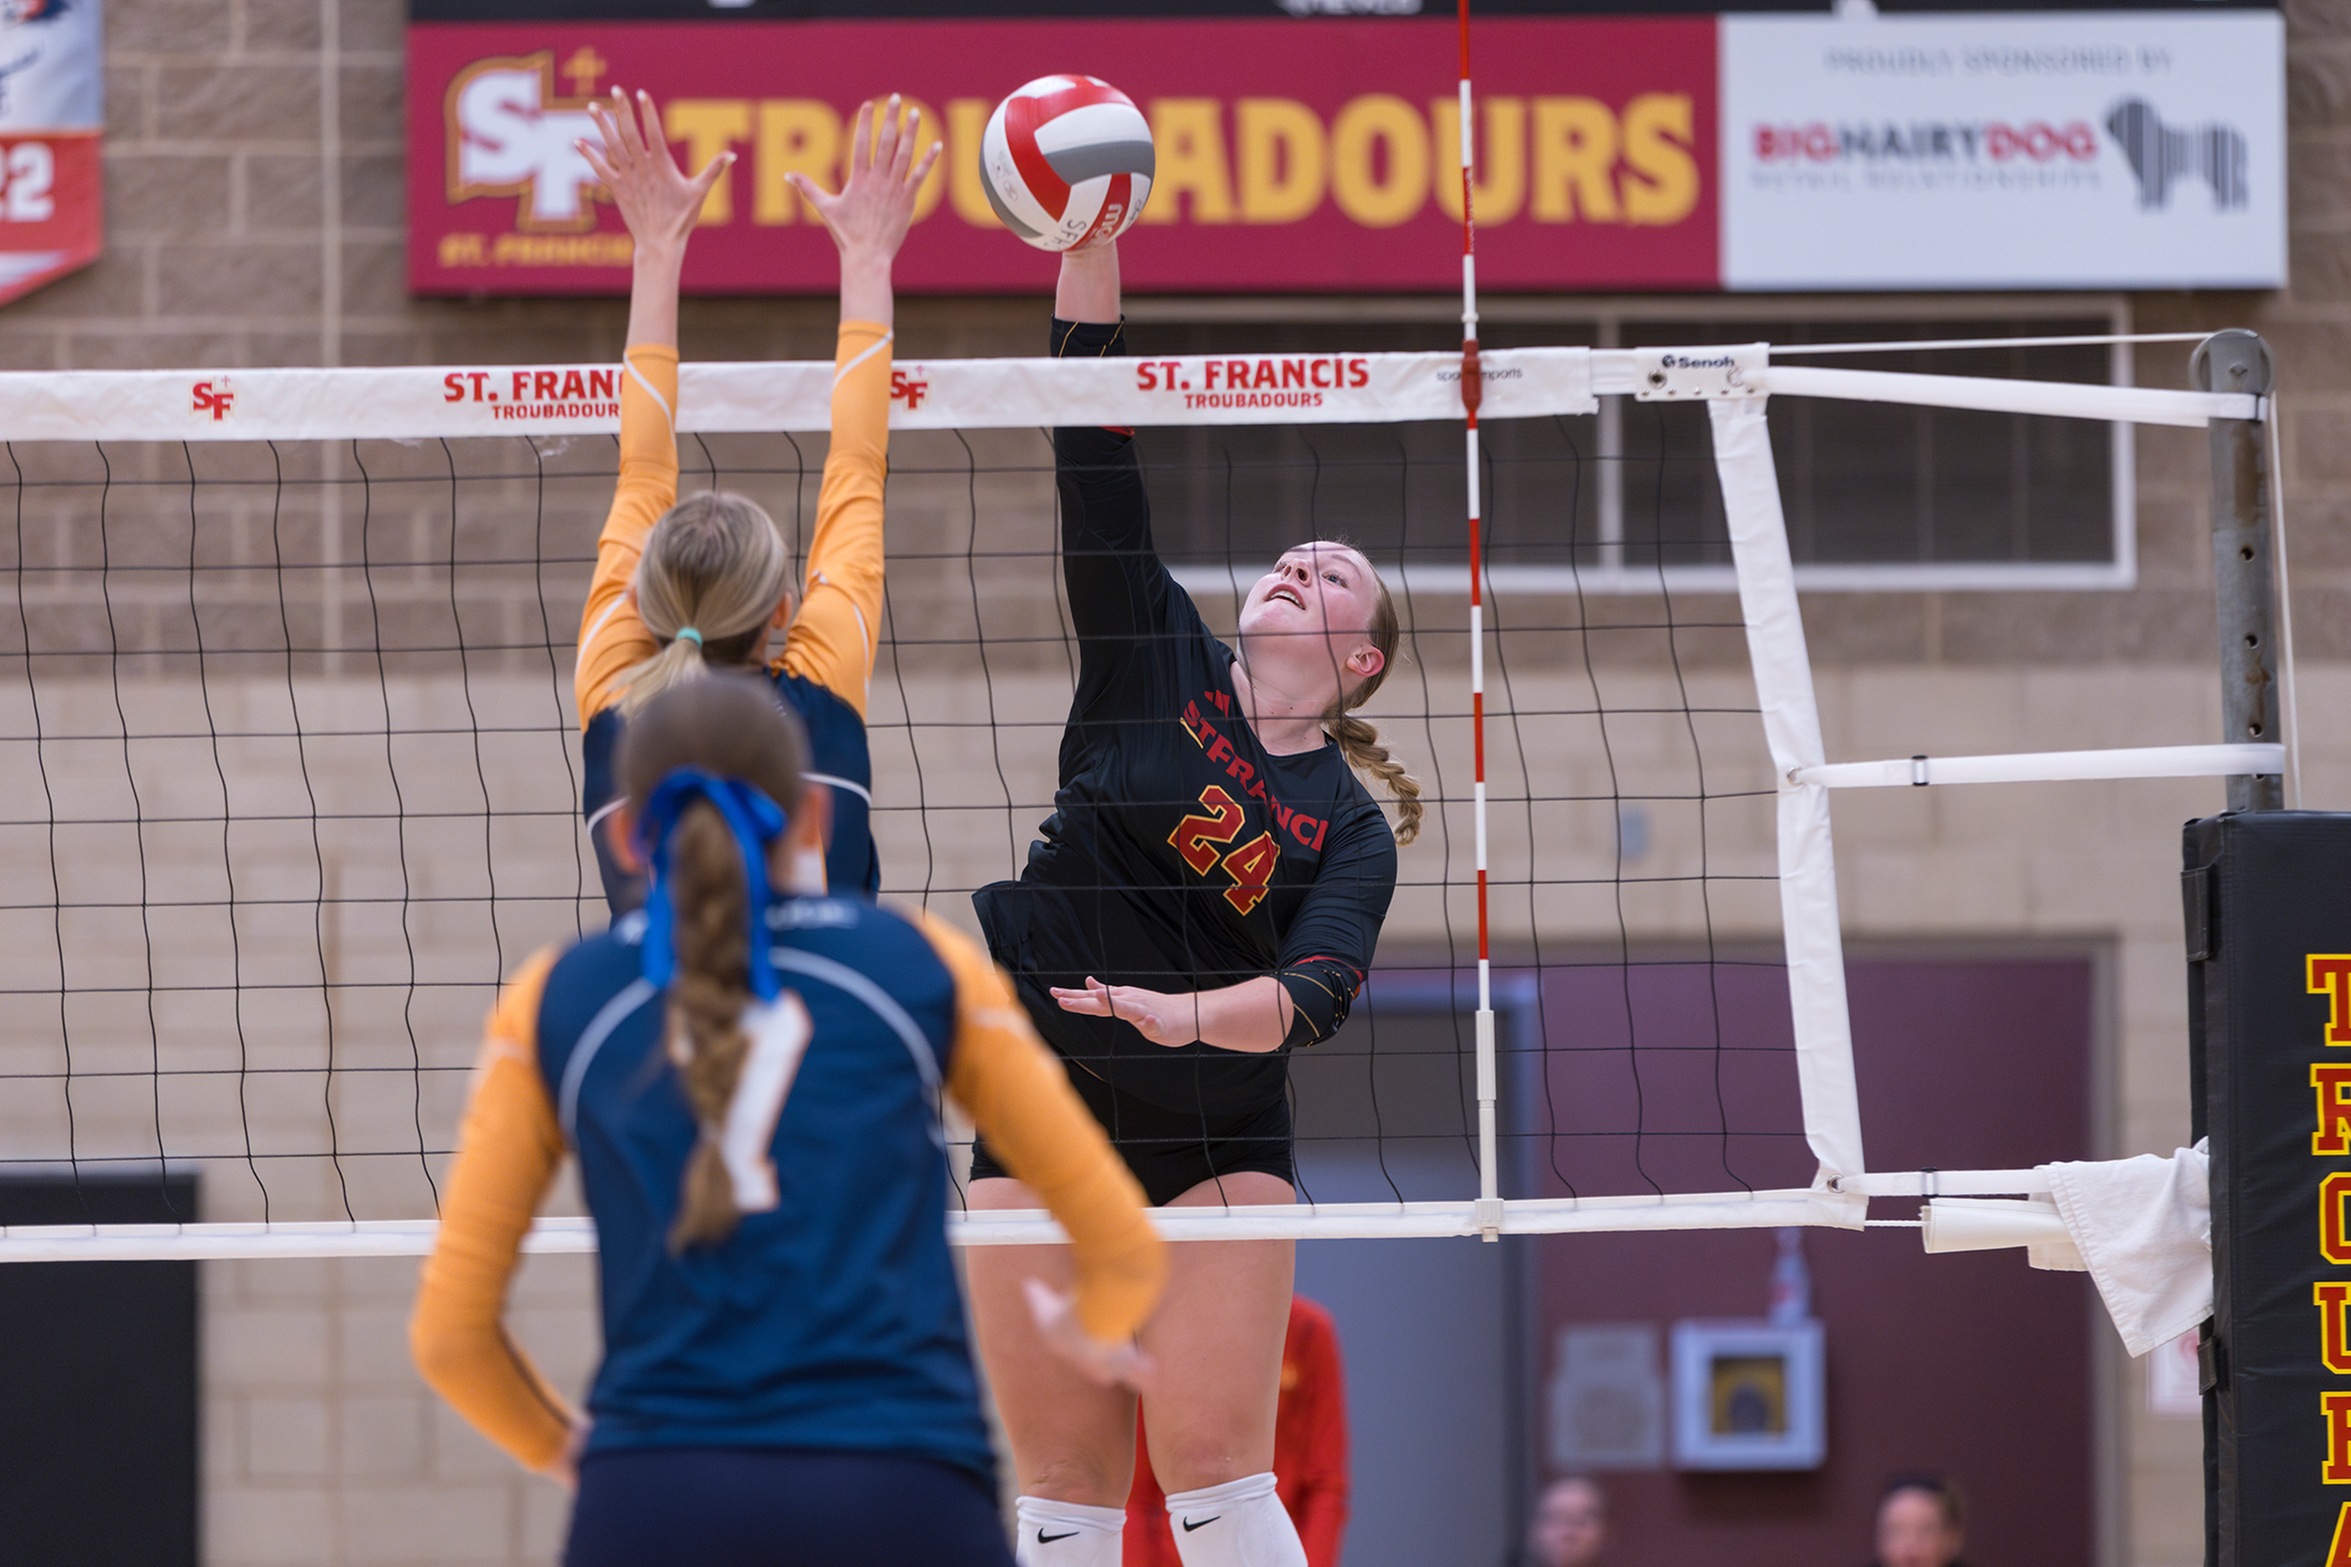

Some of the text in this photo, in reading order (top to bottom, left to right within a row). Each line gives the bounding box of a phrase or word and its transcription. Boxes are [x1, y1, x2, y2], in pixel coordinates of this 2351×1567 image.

[444, 372, 498, 403] ST.
[1137, 358, 1370, 392] ST. FRANCIS
[1184, 392, 1323, 409] TROUBADOURS
[1167, 784, 1280, 917] 24
